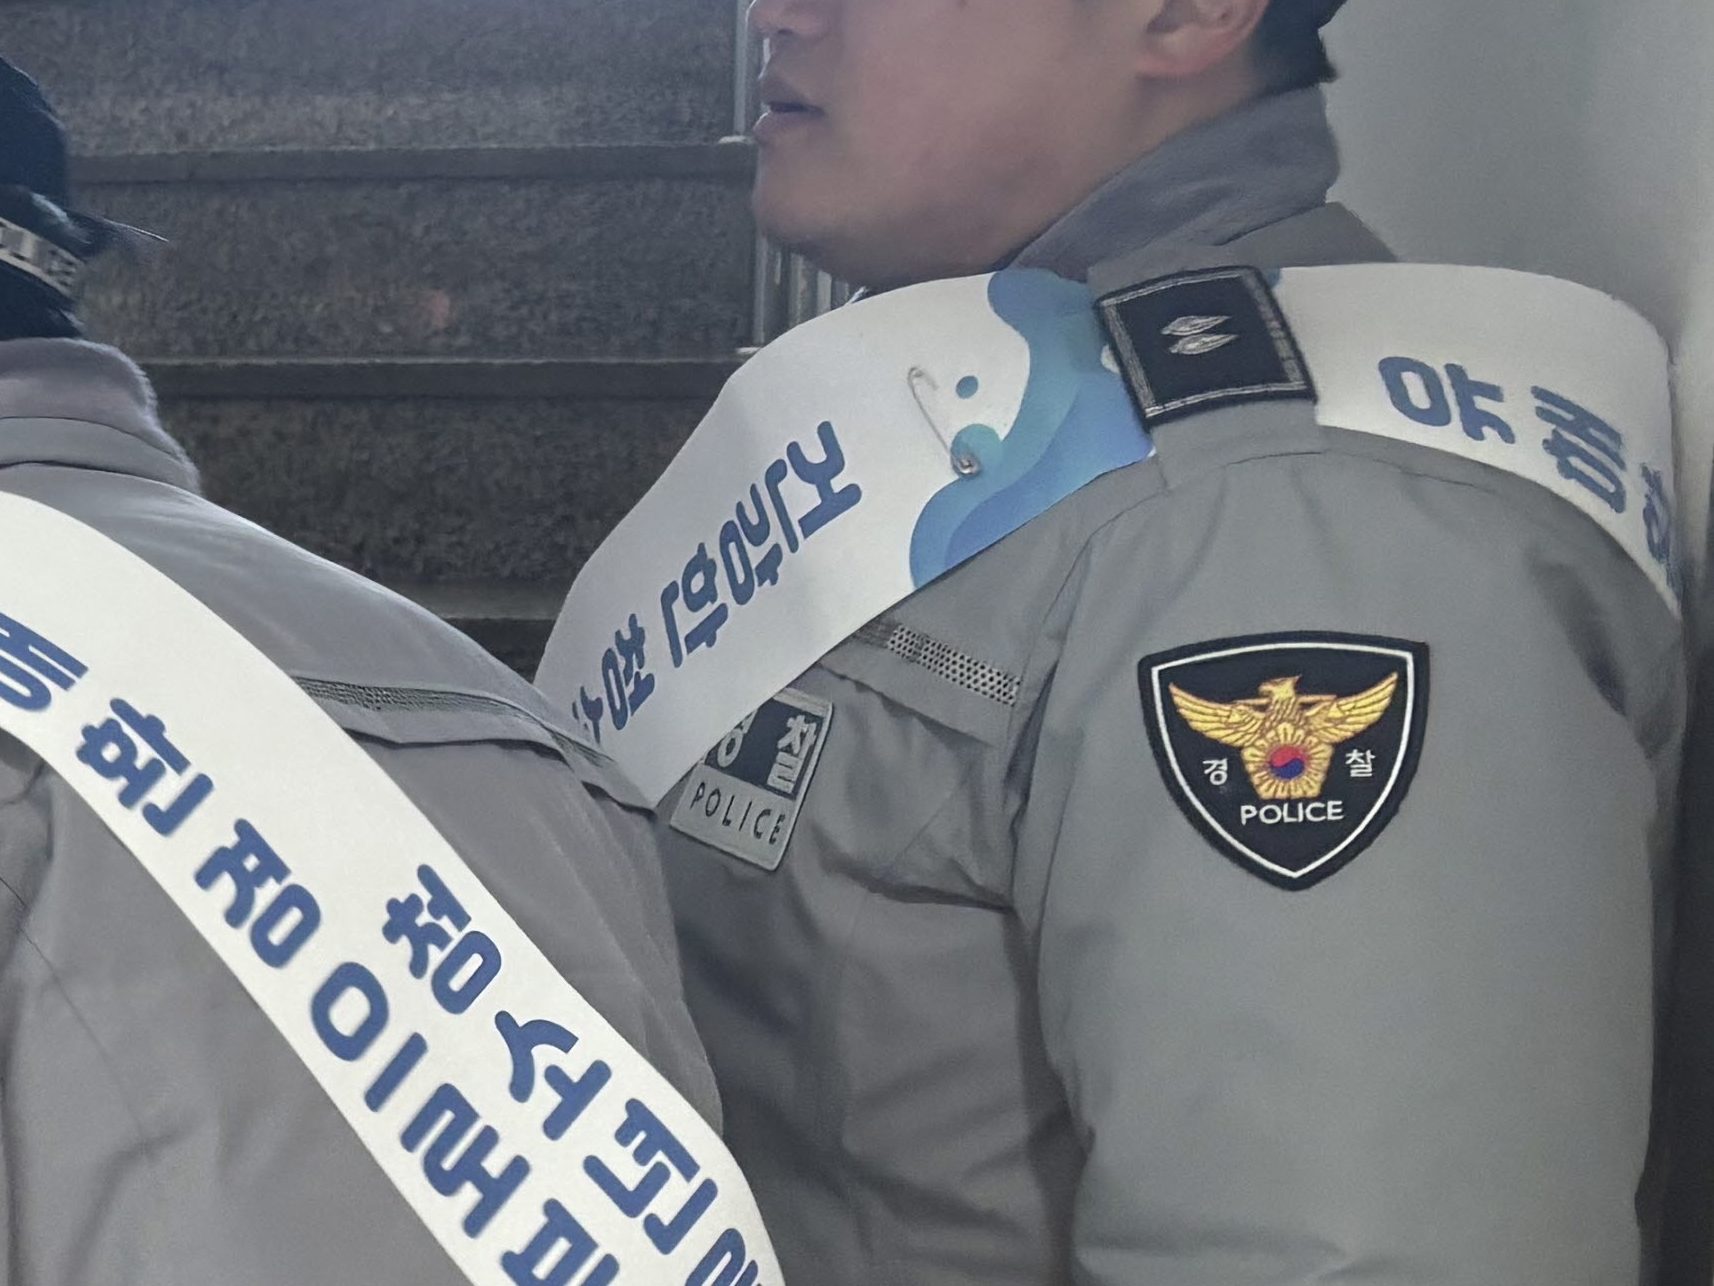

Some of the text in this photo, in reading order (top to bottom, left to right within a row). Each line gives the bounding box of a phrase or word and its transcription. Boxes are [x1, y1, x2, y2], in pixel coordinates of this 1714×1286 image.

[661, 420, 863, 669] 건강한
[1203, 749, 1376, 786] 경 찰
[689, 781, 786, 845] POLICE
[1240, 800, 1344, 825] POLICE
